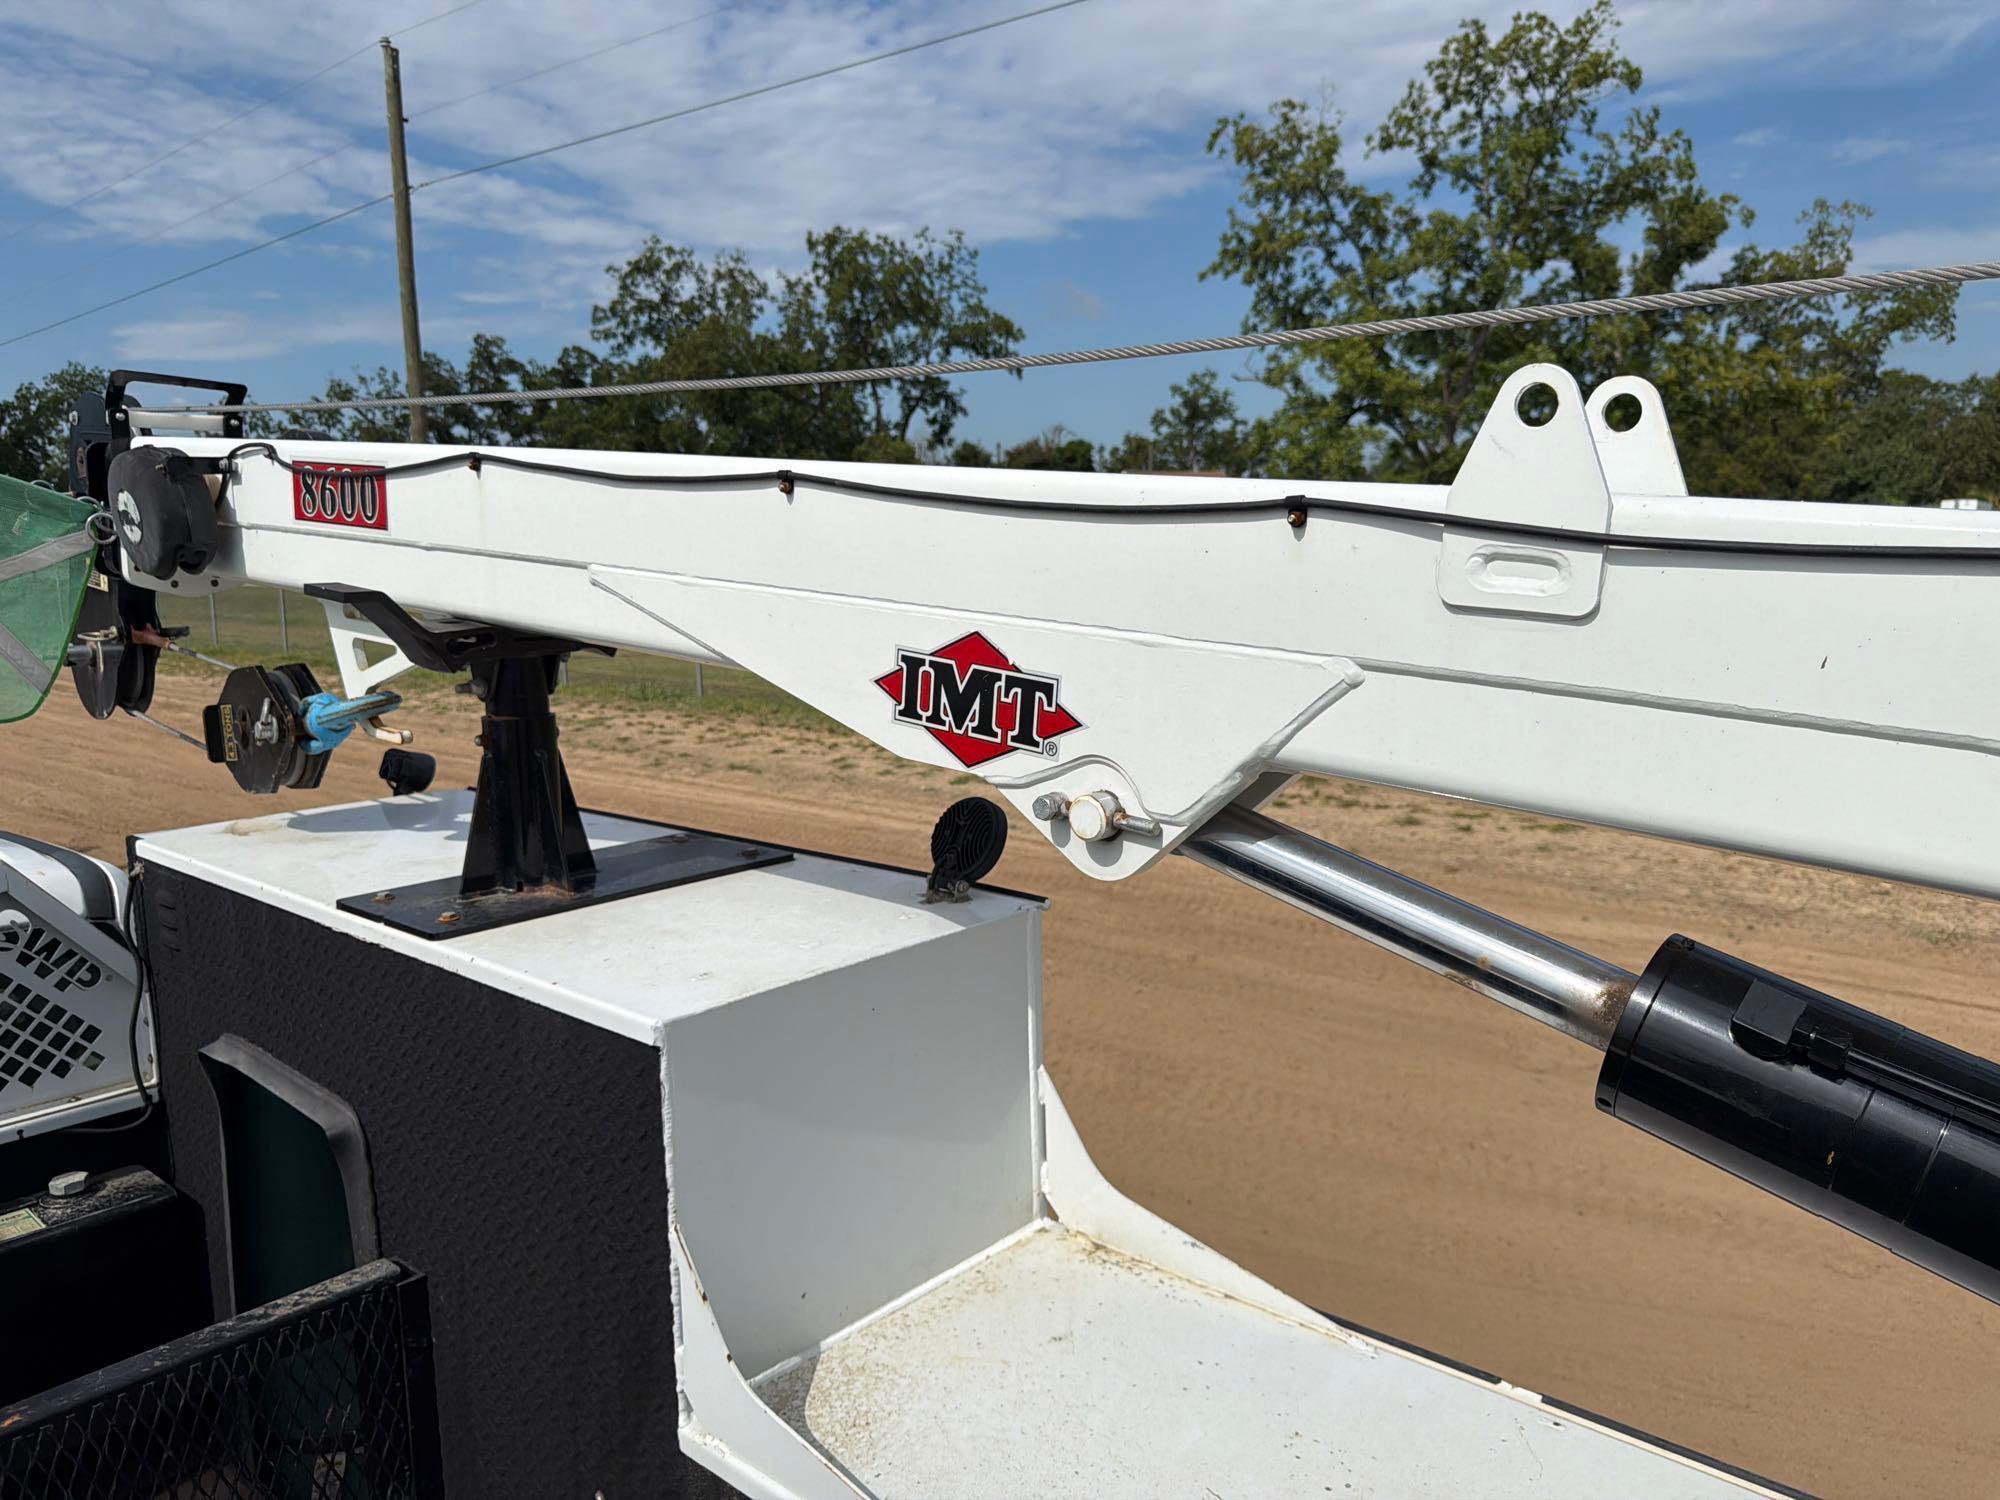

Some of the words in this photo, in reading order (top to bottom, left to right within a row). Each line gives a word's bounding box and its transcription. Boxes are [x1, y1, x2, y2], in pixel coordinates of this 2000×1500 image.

[301, 465, 379, 524] 8600
[223, 707, 233, 738] TONS
[896, 650, 1058, 753] IMT
